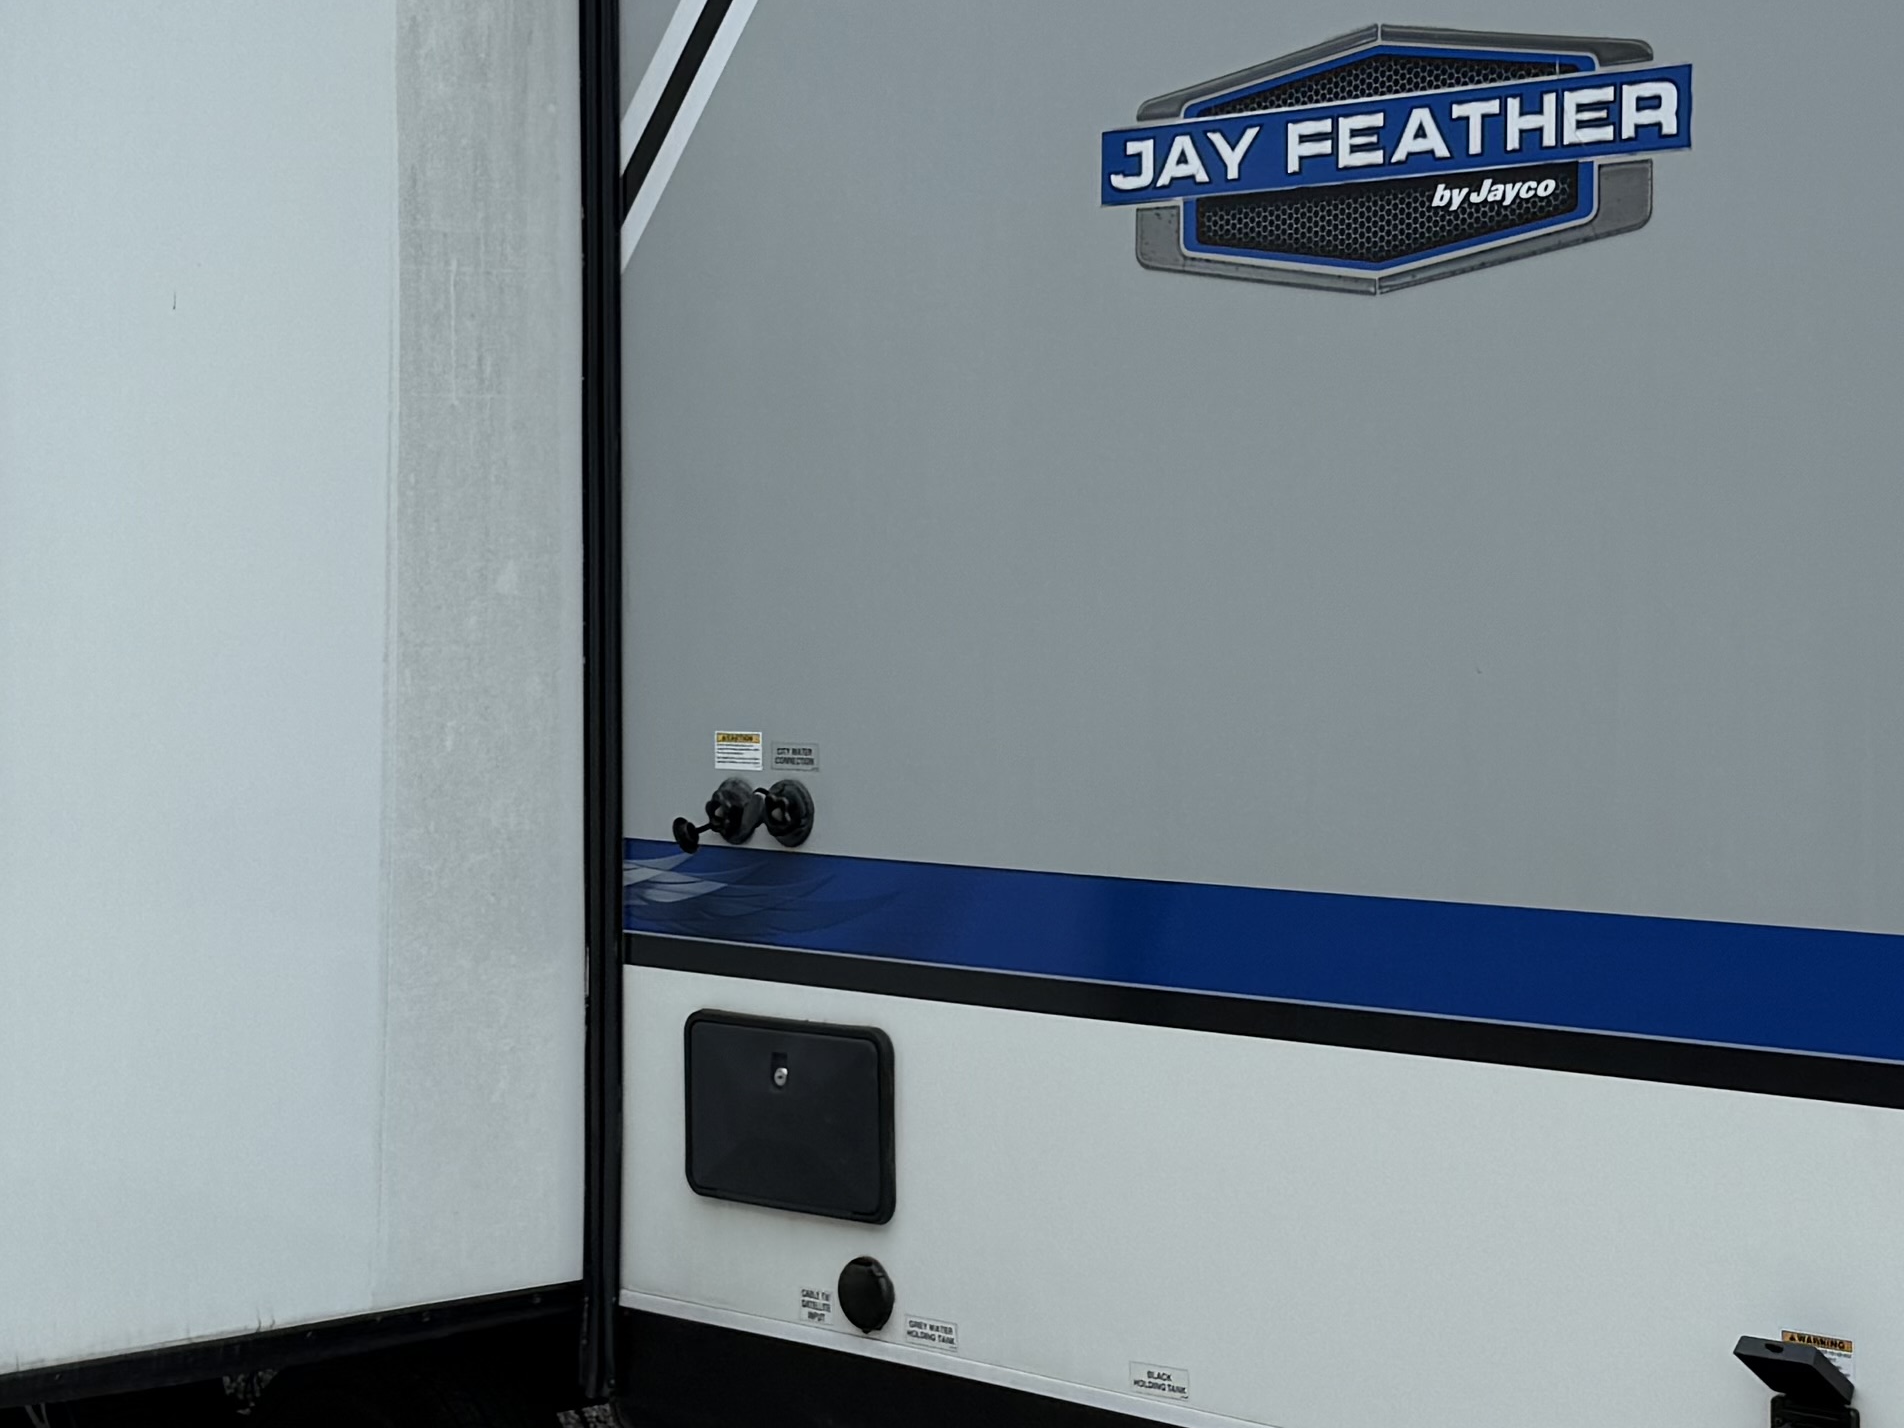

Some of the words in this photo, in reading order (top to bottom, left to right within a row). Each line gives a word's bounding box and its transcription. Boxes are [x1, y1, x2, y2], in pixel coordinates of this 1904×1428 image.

[1110, 126, 1260, 190] JAY
[1287, 81, 1678, 173] FEATHER
[1432, 184, 1469, 211] by
[1469, 178, 1556, 206] Jayco
[1797, 1333, 1845, 1349] WARNING
[1147, 1371, 1172, 1381] BLACK
